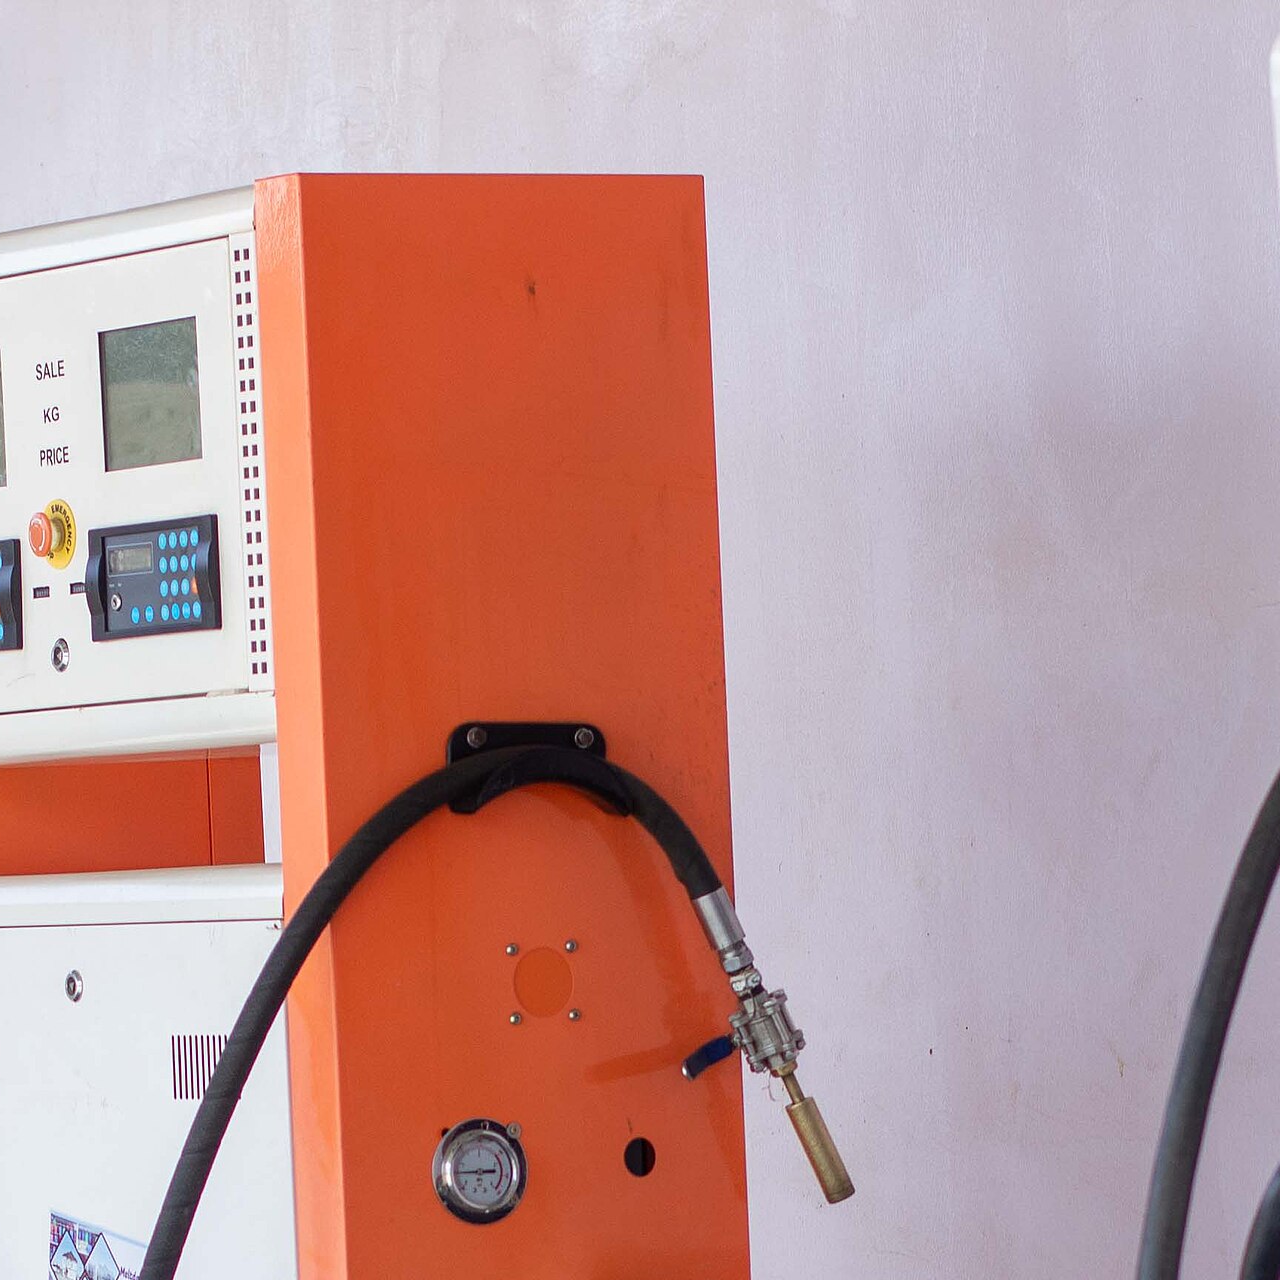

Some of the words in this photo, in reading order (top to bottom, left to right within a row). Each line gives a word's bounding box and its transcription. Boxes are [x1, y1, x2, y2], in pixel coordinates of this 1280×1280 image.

[35, 360, 65, 381] SALE
[43, 406, 60, 424] KG
[39, 446, 69, 467] PRICE
[50, 504, 72, 554] EMERGENCY
